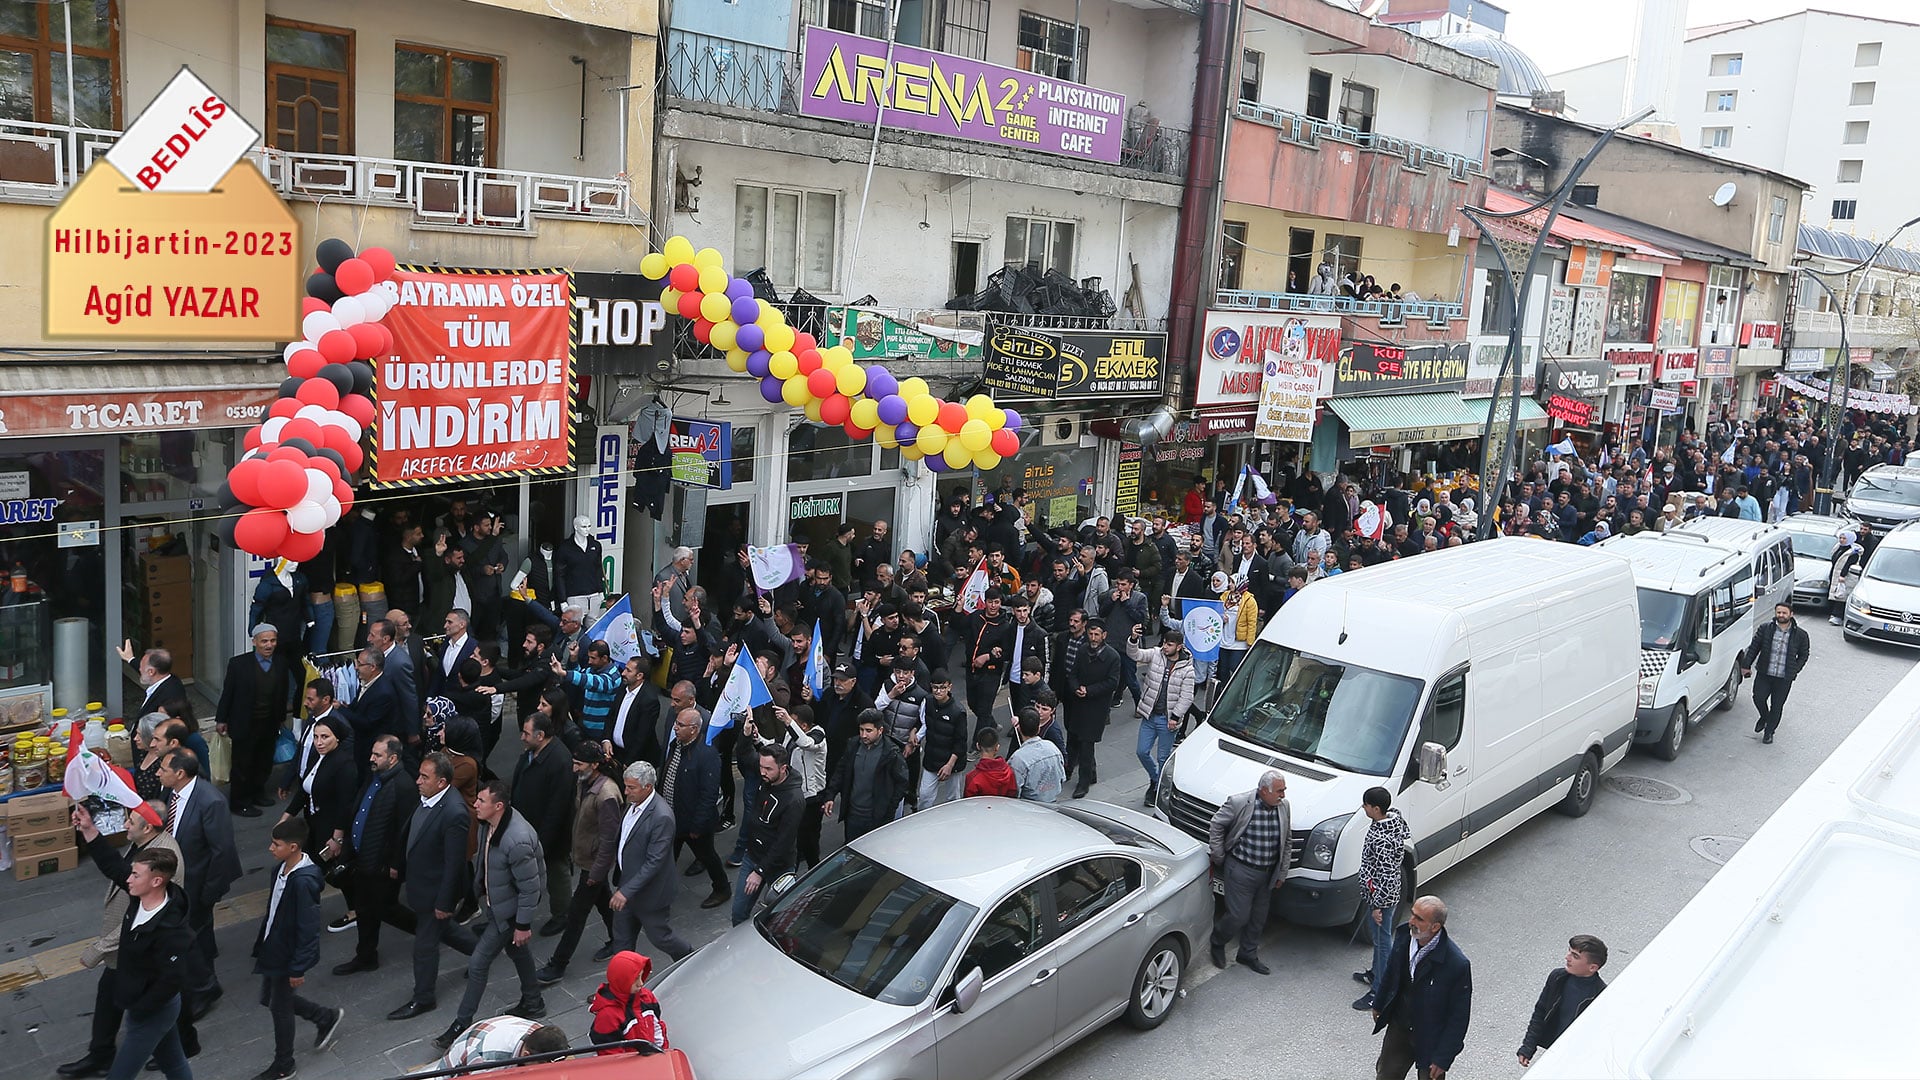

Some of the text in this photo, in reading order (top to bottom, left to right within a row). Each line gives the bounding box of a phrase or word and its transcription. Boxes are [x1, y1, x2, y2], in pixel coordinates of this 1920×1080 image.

[811, 42, 1019, 131] ARENA 2
[1038, 81, 1120, 115] PLAYSTATION
[1006, 112, 1037, 129] GAME
[1000, 126, 1040, 144] CENTER
[1060, 133, 1092, 154] CAFE
[384, 278, 566, 307] BAYRAMA ÖZEL
[444, 314, 511, 348] TÜM
[577, 297, 667, 346] HOP
[1061, 342, 1085, 358] EZZET
[384, 355, 563, 390] ÜRÜNLERDE
[1011, 367, 1056, 381] LAHMACUN
[1016, 359, 1043, 371] EKMEK
[1095, 358, 1158, 378] EKMEK
[1420, 359, 1431, 380] VE
[1431, 355, 1441, 383] İÇ
[1442, 354, 1467, 380] GİYİM
[1763, 380, 1774, 395] E
[381, 395, 561, 451] İNDİRİM
[1208, 418, 1247, 430] AKKOYUN
[401, 450, 517, 478] AREFEYE KADAR
